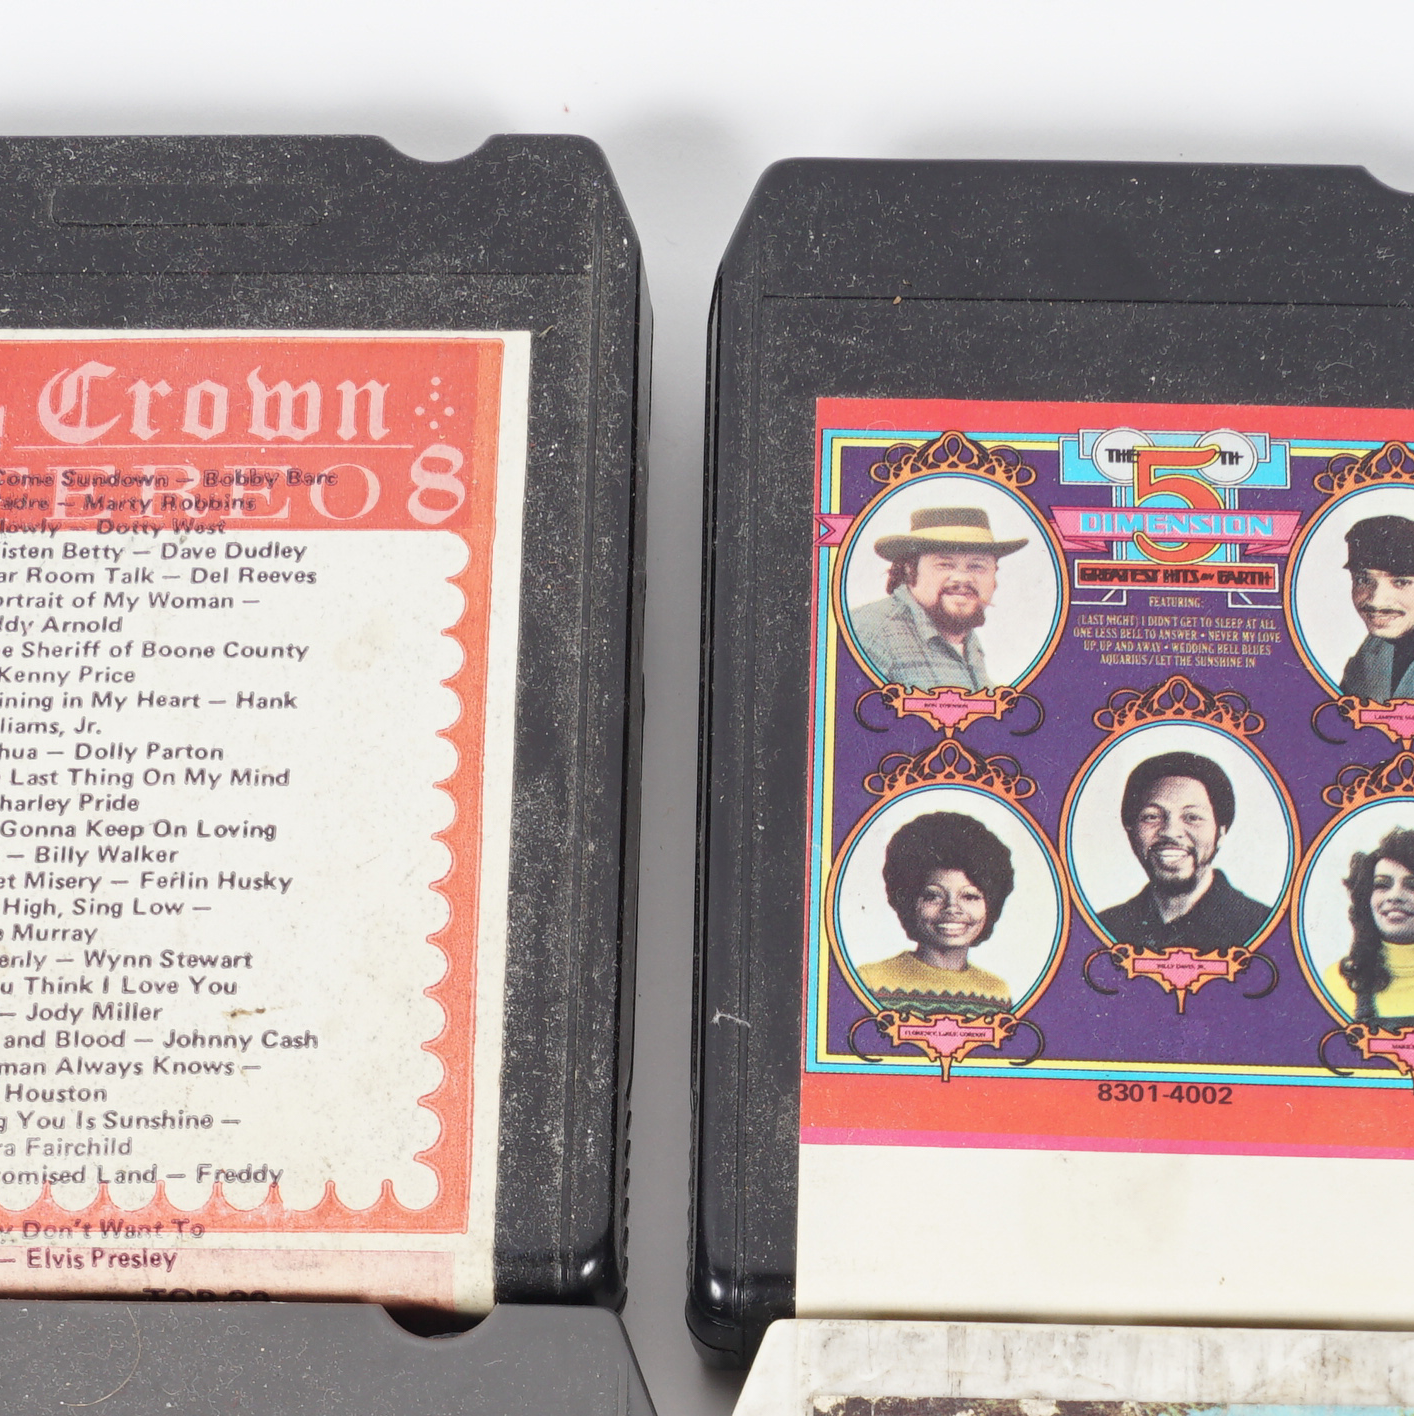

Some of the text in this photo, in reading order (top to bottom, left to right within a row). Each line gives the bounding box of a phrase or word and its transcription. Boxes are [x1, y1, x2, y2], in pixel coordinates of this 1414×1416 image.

[37, 360, 391, 444] Crown
[407, 444, 465, 524] 8
[1080, 512, 1273, 536] DIMENSION
[1080, 567, 1272, 586] GREATEST HITS EARTH
[1148, 596, 1204, 608] FEATURING:
[41, 616, 123, 633] Arnold
[1073, 627, 1280, 642] ONE LESS BELL TO ANSWER NEVER MY LOVE
[21, 640, 100, 658] Sheriff
[109, 640, 133, 657] of
[142, 641, 215, 658] Boone
[223, 641, 309, 662] County
[1100, 654, 1255, 667] AQUARIUS/LET THE SUNSHINE IN
[74, 716, 101, 734] Jr.
[10, 768, 58, 786] Last
[67, 768, 133, 789] Thing
[143, 768, 175, 786] On
[184, 767, 221, 790] My
[230, 768, 290, 786] Mind
[12, 923, 97, 945] Murray
[5, 1083, 107, 1103] Houston
[1098, 1083, 1232, 1104] 8301-4002
